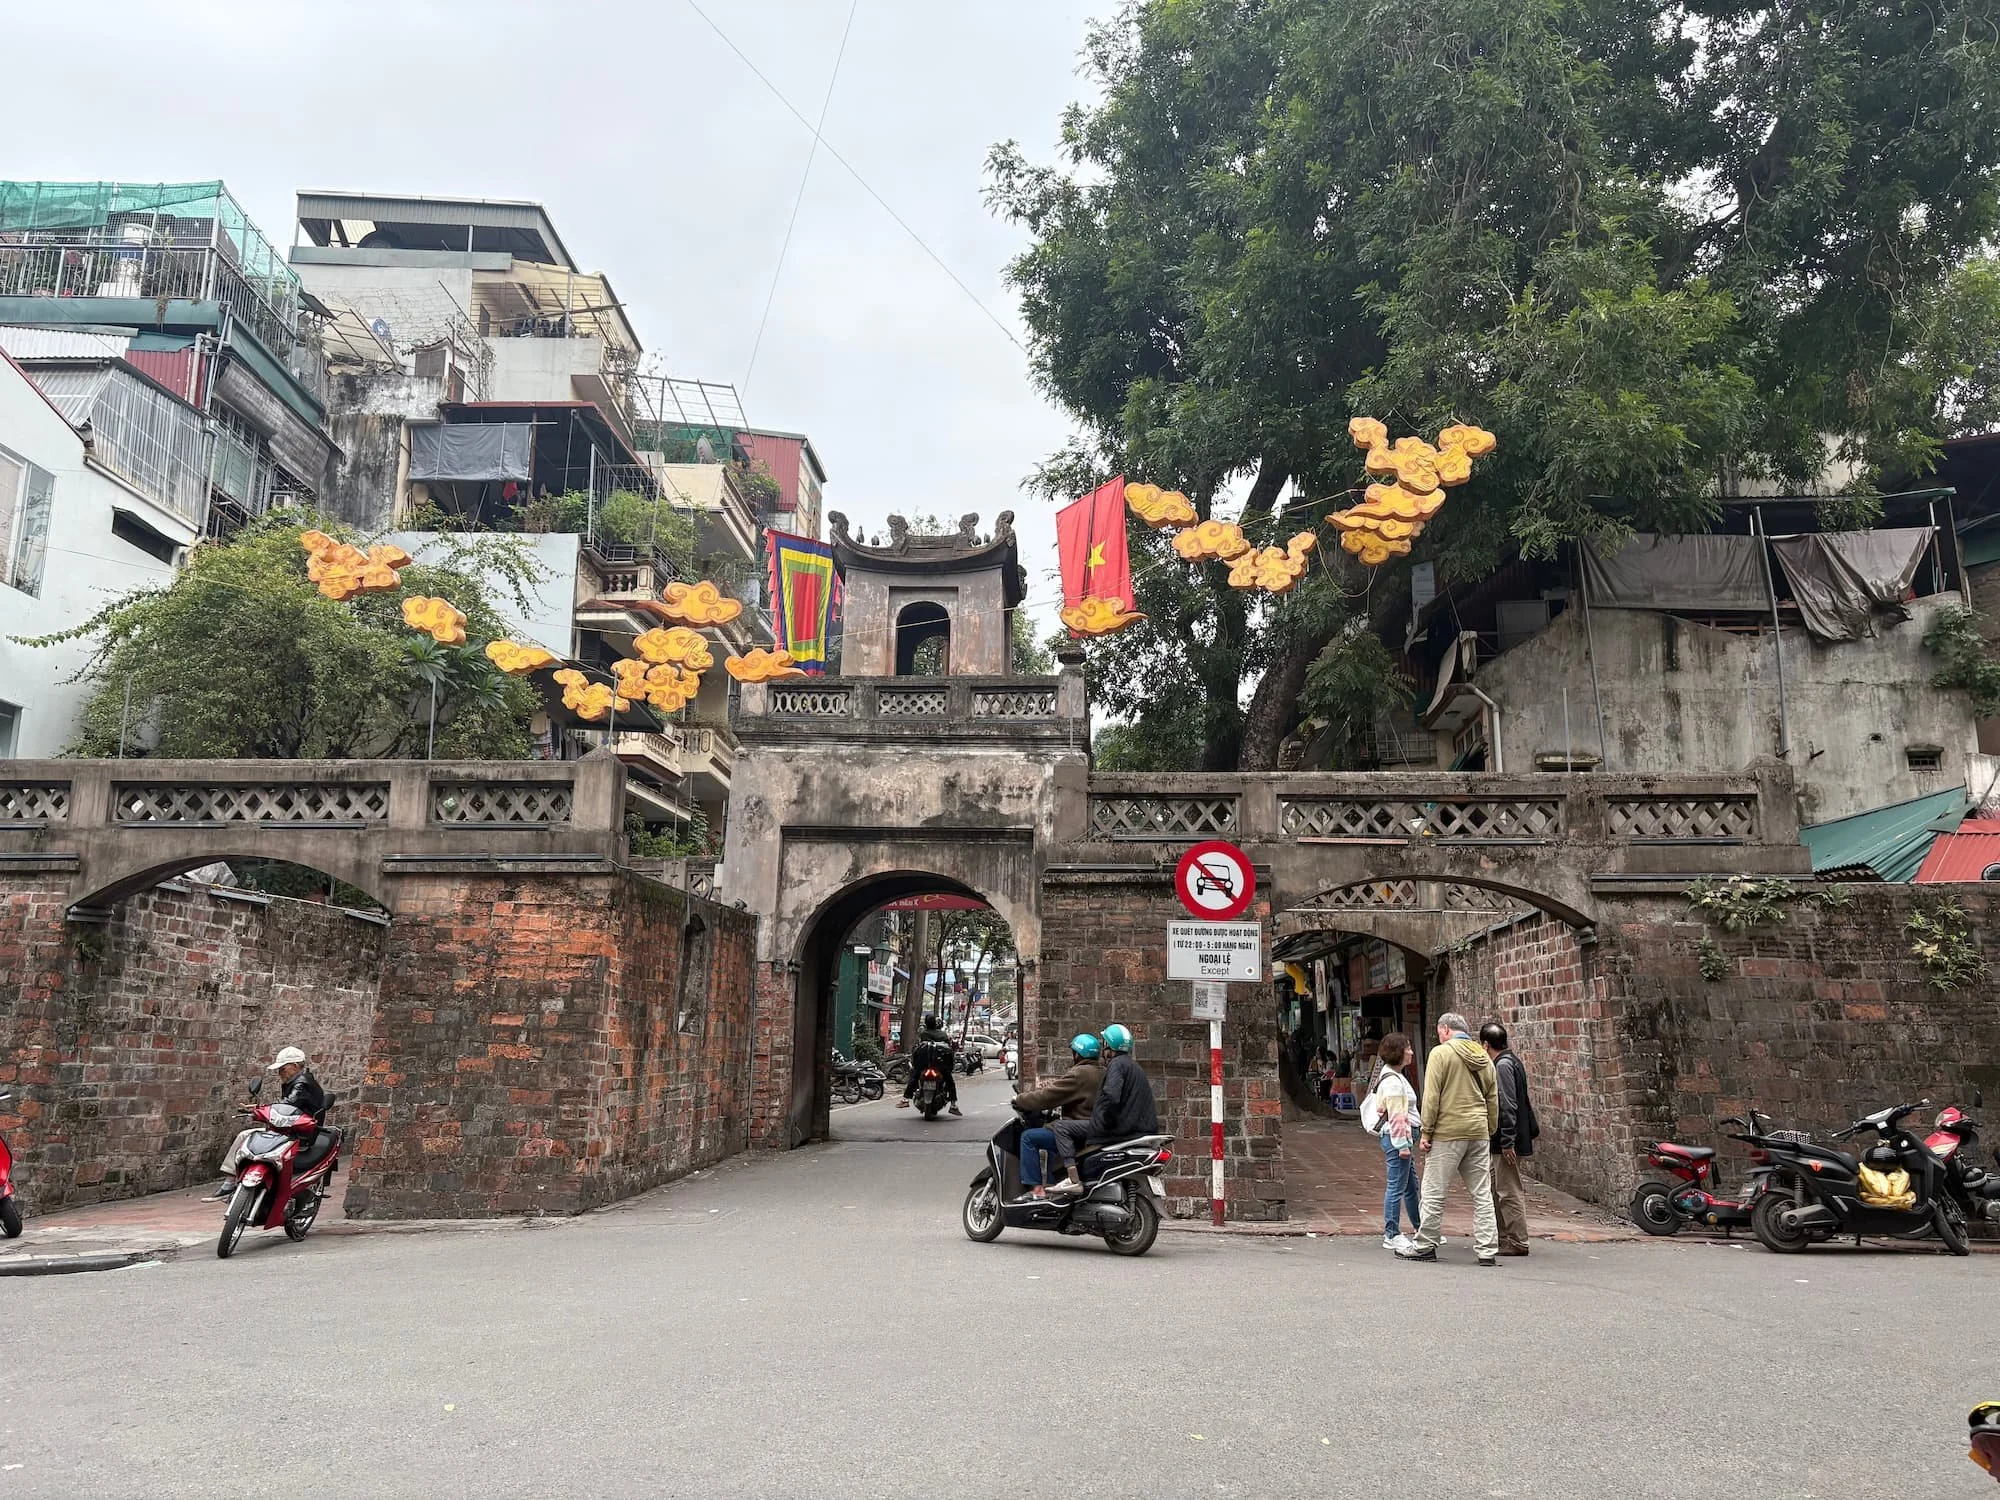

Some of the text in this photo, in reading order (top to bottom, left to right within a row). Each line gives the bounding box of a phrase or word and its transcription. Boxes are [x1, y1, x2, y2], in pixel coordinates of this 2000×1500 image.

[1172, 927, 1179, 935] XE
[1199, 953, 1231, 966] NGOẠI LỆ
[1201, 966, 1229, 976] Except
